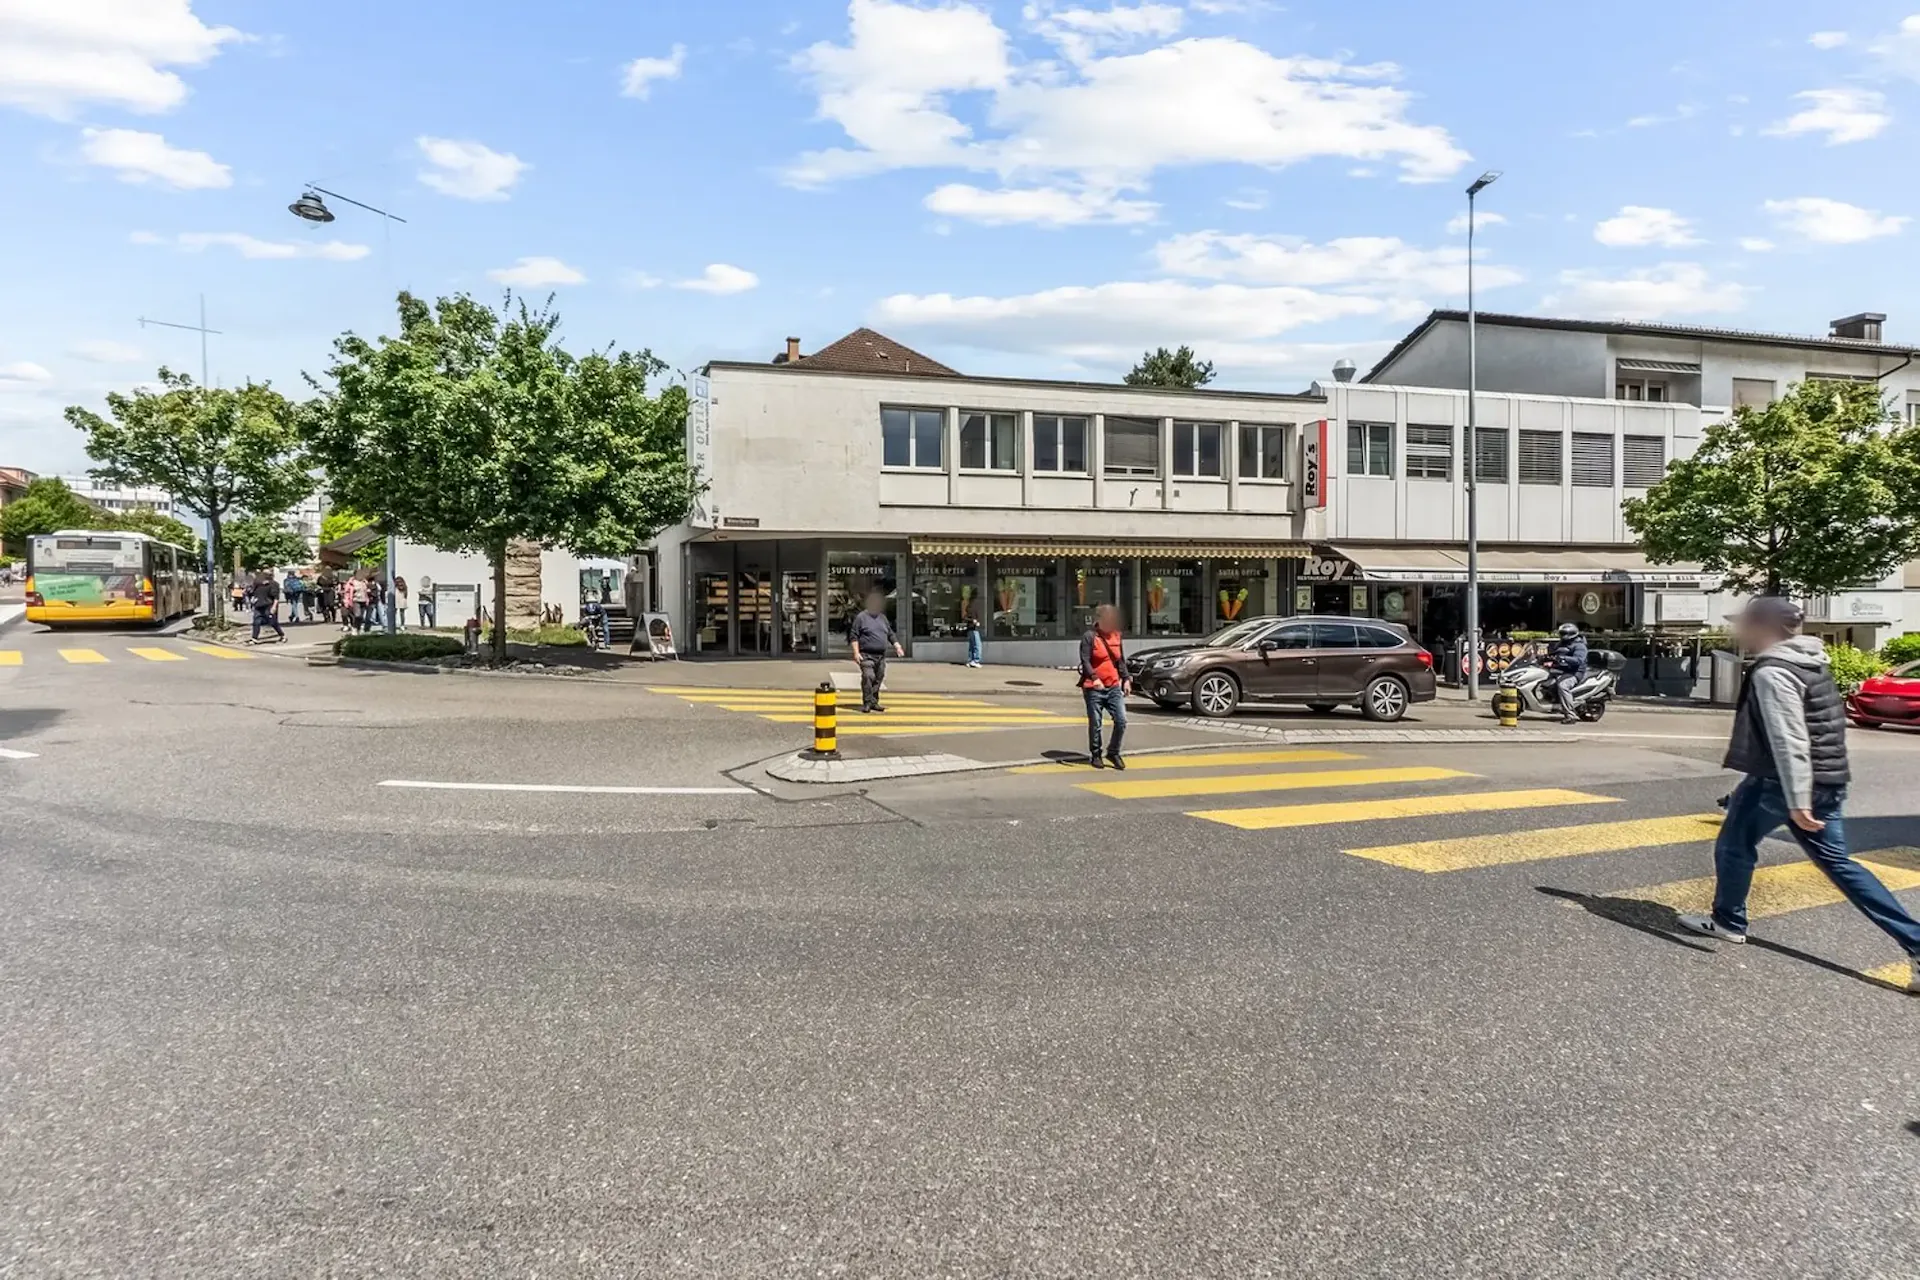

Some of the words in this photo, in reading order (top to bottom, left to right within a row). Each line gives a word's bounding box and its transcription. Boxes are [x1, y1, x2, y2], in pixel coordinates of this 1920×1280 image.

[831, 567, 856, 575] SUTER
[859, 567, 884, 575] OPTIK
[916, 567, 939, 575] SUTER
[942, 567, 965, 575] OPTIK
[997, 567, 1020, 575] SUTER
[1023, 567, 1045, 575] OPTIK
[1099, 567, 1120, 575] OPTIK
[1150, 568, 1171, 576] SUTER
[1173, 568, 1194, 576] OPTIK
[1218, 568, 1239, 577] SUTER
[1241, 568, 1261, 577] OPTIK
